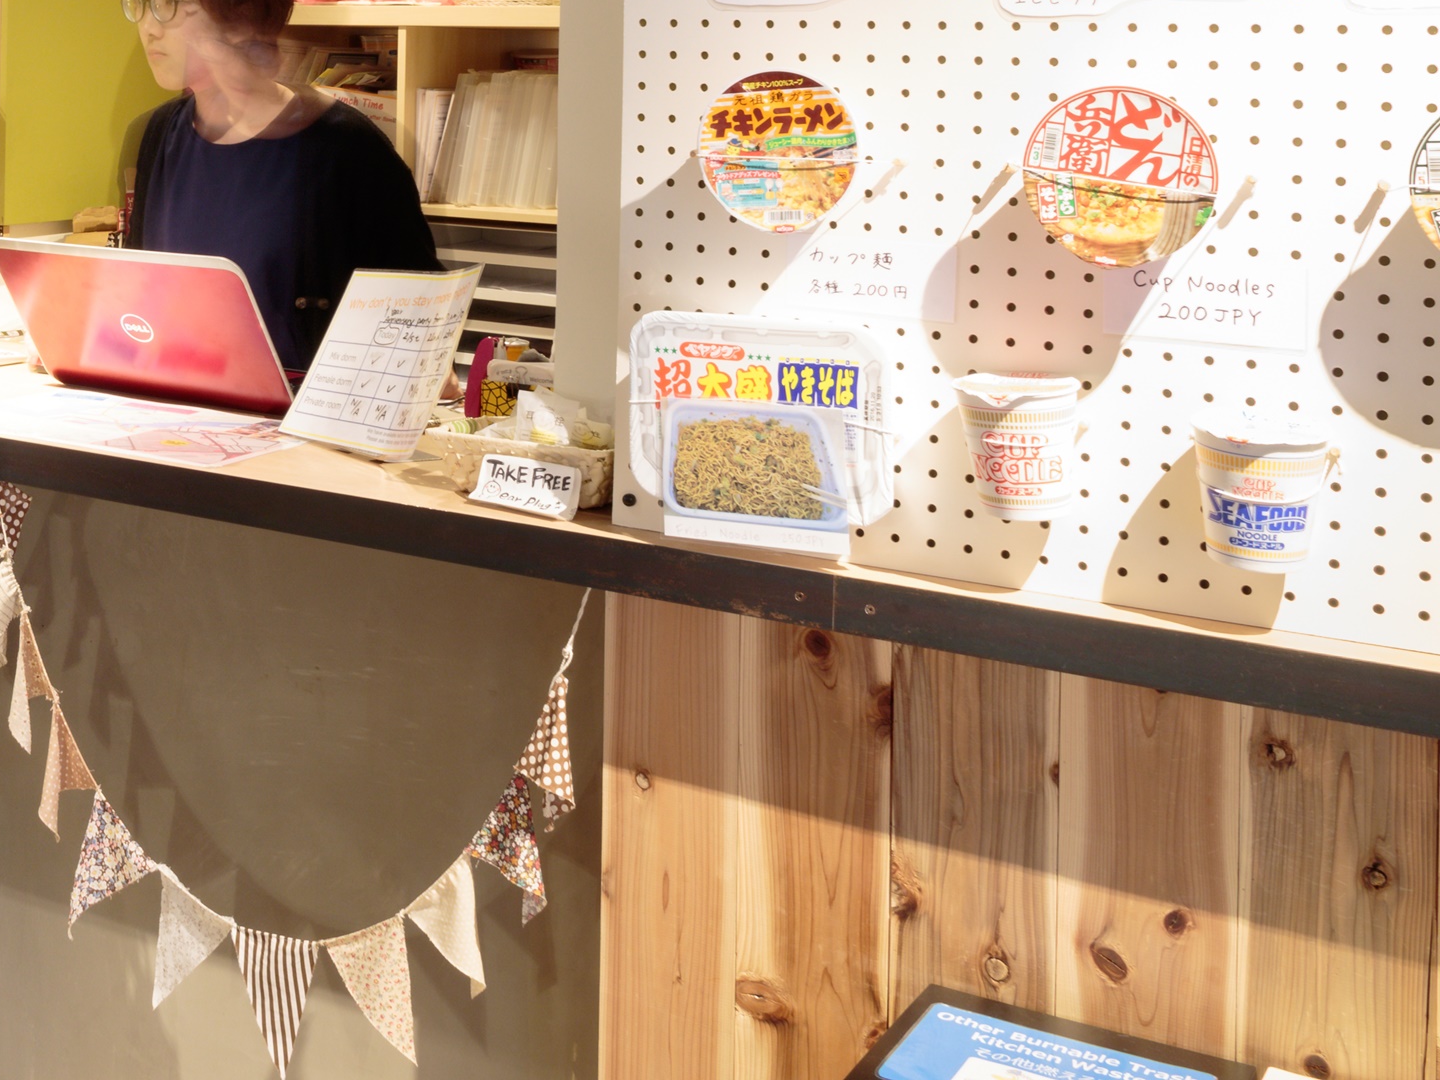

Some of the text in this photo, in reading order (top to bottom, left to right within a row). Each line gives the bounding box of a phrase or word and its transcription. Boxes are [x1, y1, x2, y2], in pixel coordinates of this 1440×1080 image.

[363, 97, 384, 110] Time
[734, 91, 814, 106] 元祖鶏ガラ
[709, 103, 844, 138] チキンラーメン
[1060, 94, 1112, 174] 兵衛
[1106, 91, 1183, 188] どん
[1182, 137, 1204, 188] 日清の
[1040, 186, 1059, 220] そば
[809, 247, 894, 271] カップ麺
[808, 279, 908, 299] 各種 200円
[1133, 270, 1275, 299] Cup Noodles
[349, 299, 365, 310] Why
[368, 296, 392, 309] don't
[394, 298, 410, 308] you
[412, 296, 432, 308] stay
[1158, 302, 1262, 326] 200JPY
[124, 322, 151, 334] DELL
[379, 329, 397, 341] Today
[341, 352, 357, 362] dorm
[684, 344, 741, 359] ペヤング
[315, 374, 353, 387] Female dorm
[654, 357, 773, 404] 超大盛
[781, 364, 856, 407] やきそば
[304, 396, 342, 410] Private room
[980, 430, 1049, 461] CUP
[486, 458, 572, 492] TAKE FREE
[499, 491, 523, 503] ear
[1206, 487, 1309, 533] SEAFOOD
[719, 527, 760, 542] Noodle
[1237, 530, 1278, 541] NOODLE
[936, 1011, 1005, 1036] Other
[1010, 1030, 1121, 1067] Burnable
[971, 1031, 1063, 1065] Kitchen
